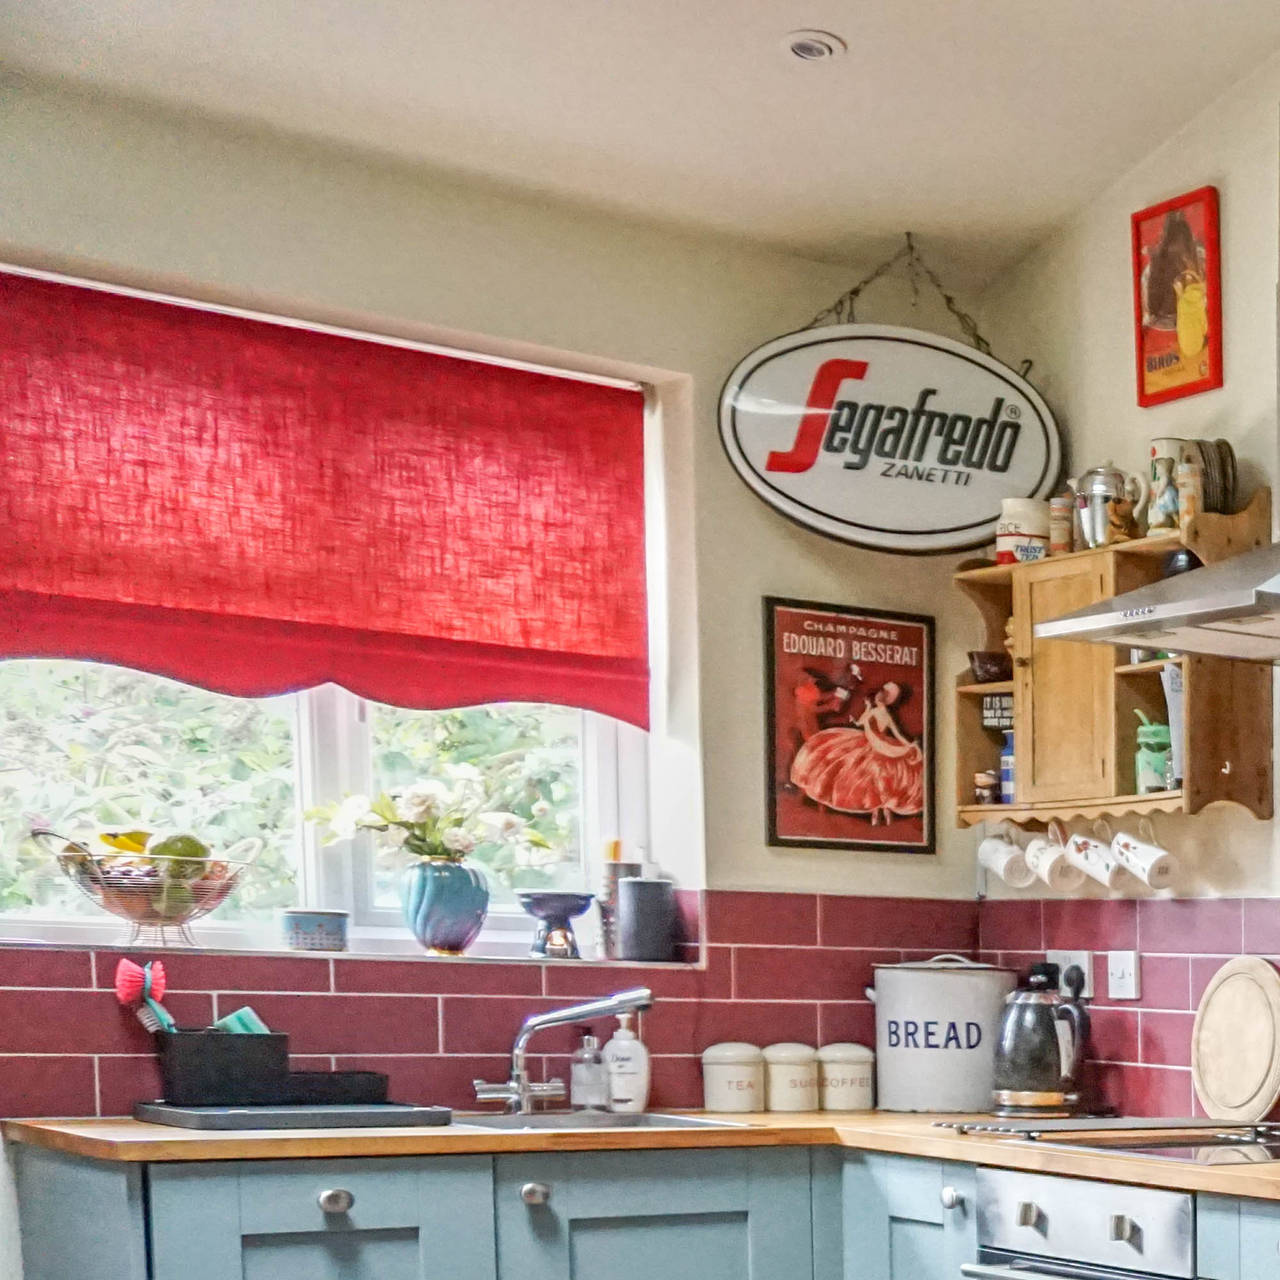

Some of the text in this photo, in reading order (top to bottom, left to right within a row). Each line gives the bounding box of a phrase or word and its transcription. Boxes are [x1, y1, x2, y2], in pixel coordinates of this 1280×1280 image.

[765, 358, 1022, 473] Segafredo
[880, 462, 972, 487] ZANETTI
[803, 620, 899, 641] CHAMPAGNE
[782, 632, 918, 666] EDOUARD BESSERAT
[887, 1020, 982, 1050] BREAD
[728, 1080, 754, 1091] TEA
[789, 1079, 819, 1089] SUG
